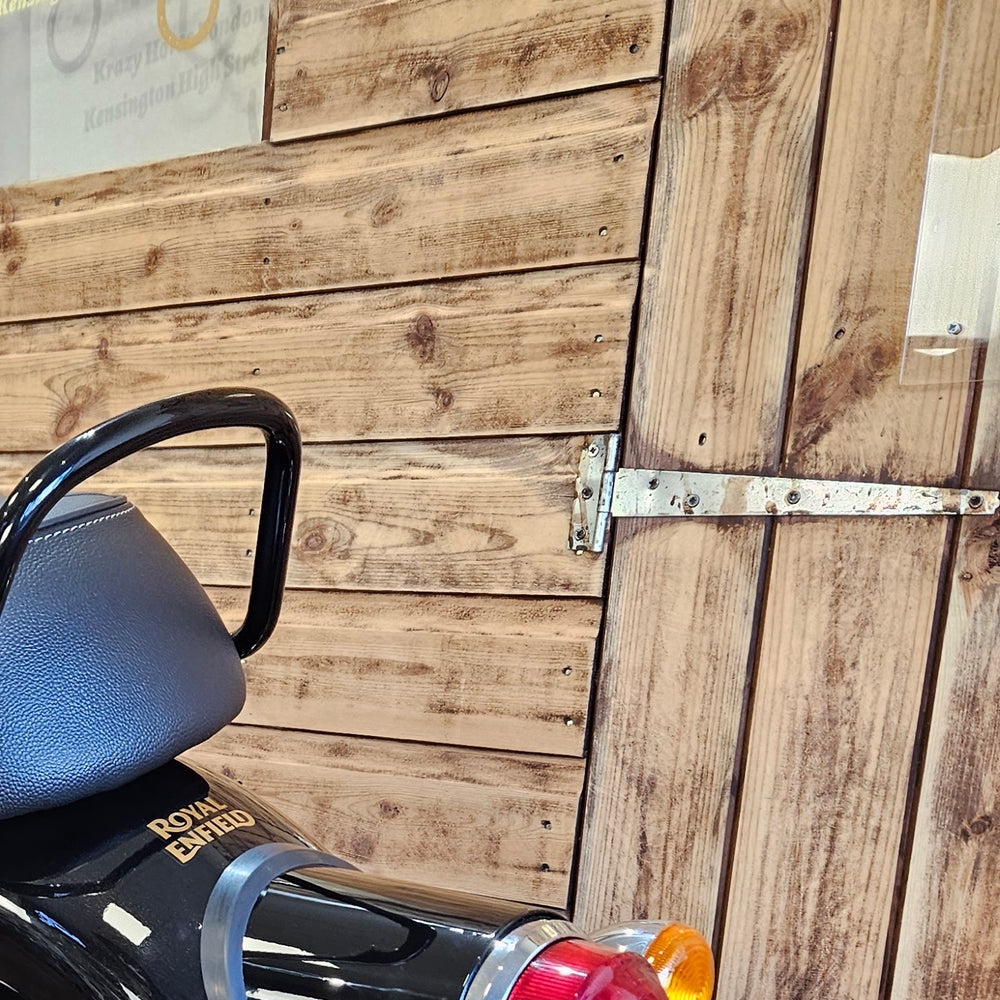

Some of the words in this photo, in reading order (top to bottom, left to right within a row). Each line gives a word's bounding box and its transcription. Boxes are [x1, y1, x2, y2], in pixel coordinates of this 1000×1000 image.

[92, 52, 142, 85] Krazy
[83, 82, 175, 133] Kensington
[146, 797, 228, 840] ROYAL
[164, 809, 256, 864] ENFIELD
